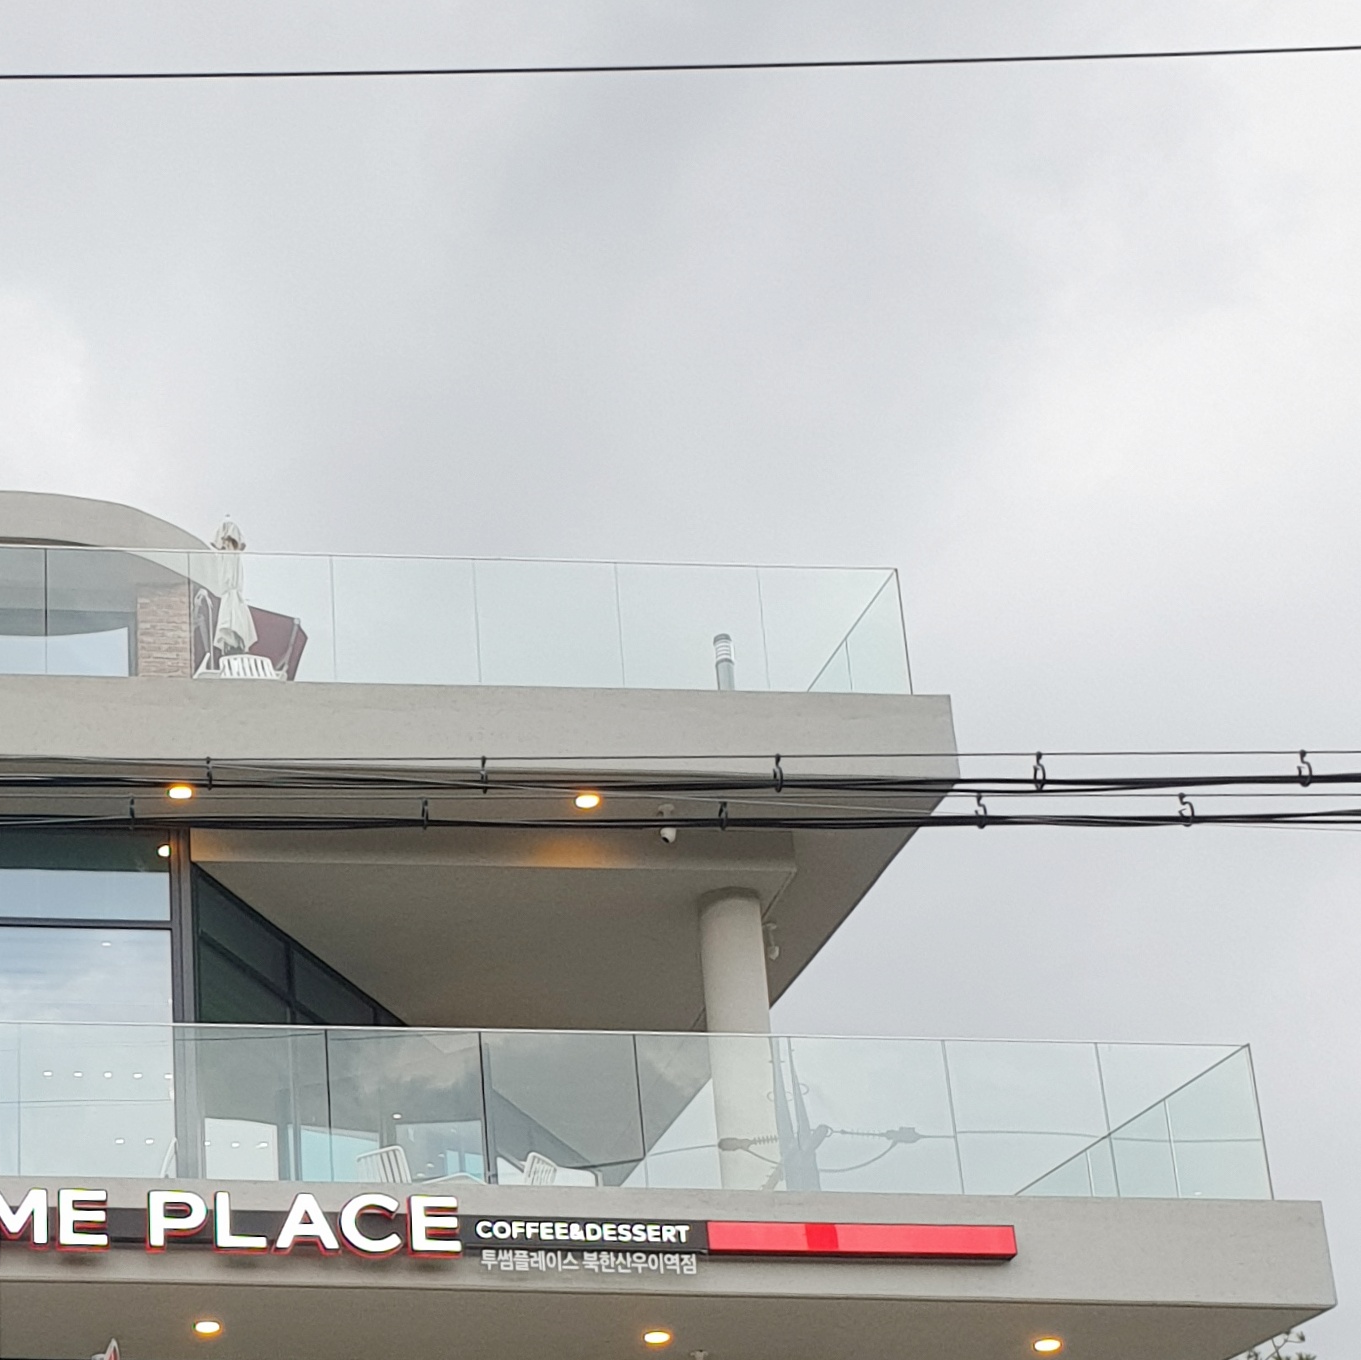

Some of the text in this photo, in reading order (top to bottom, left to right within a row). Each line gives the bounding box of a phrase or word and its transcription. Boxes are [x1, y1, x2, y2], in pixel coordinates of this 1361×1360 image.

[146, 1189, 464, 1258] PLACE
[475, 1220, 690, 1243] COFFEE&DESSERT
[481, 1248, 697, 1275] 투썸플레이스 북한산우이역점
